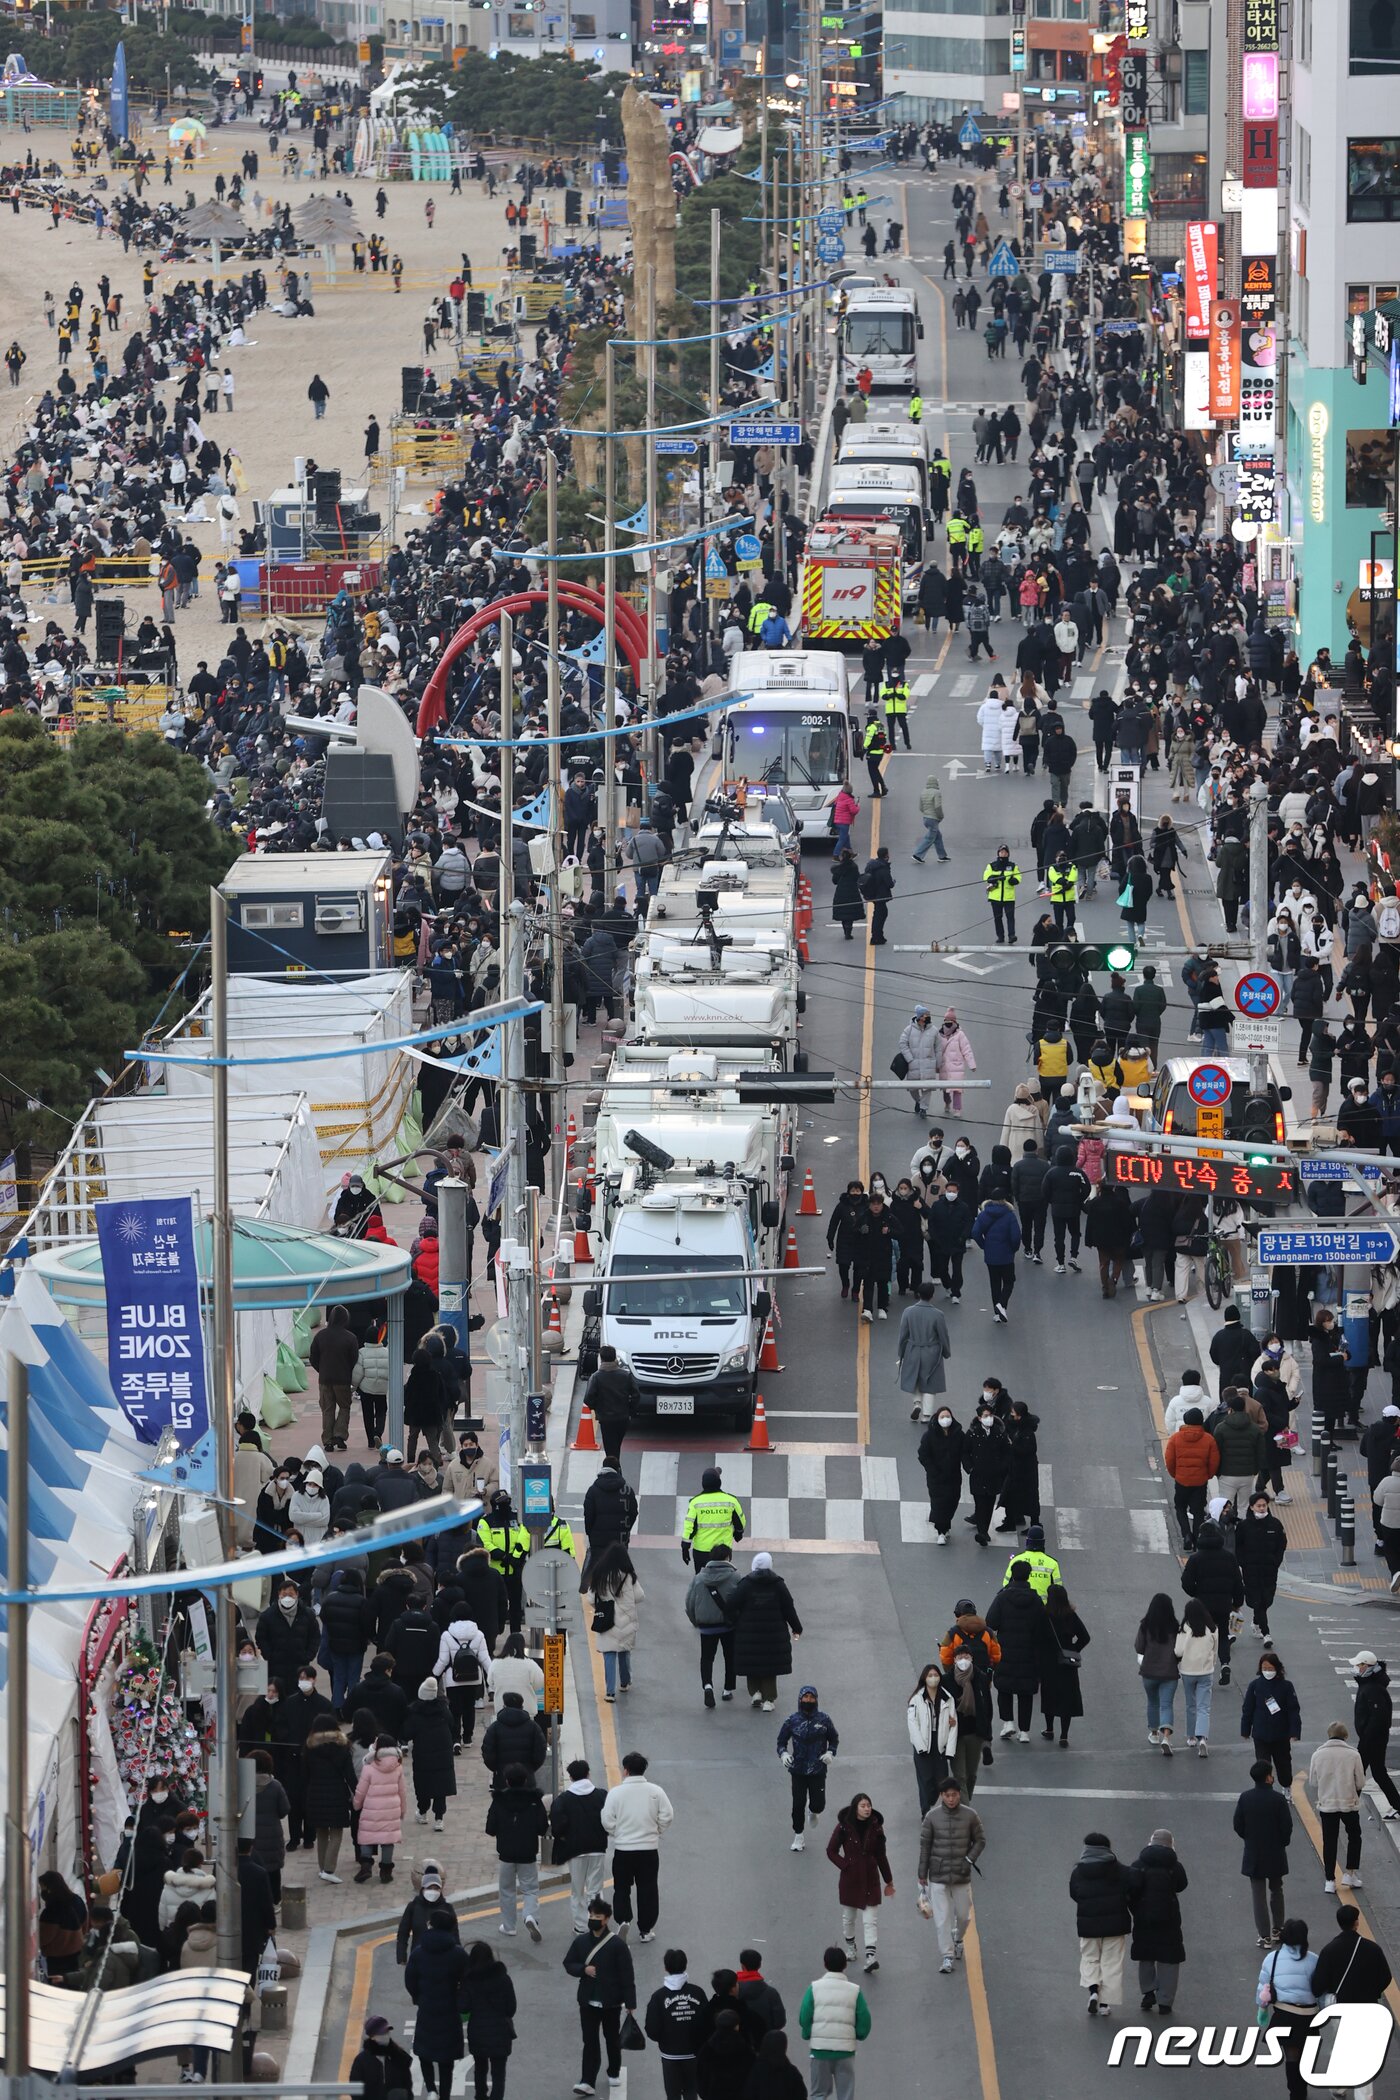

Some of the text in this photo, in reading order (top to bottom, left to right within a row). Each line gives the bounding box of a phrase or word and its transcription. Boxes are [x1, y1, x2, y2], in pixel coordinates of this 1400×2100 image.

[1128, 26, 1148, 37] 4F
[1247, 129, 1273, 159] H
[1216, 329, 1232, 394] 홍콩반점
[1242, 379, 1274, 388] DOO
[1242, 412, 1273, 421] NUT
[736, 426, 783, 436] 광안해변로
[832, 585, 867, 600] 119
[801, 715, 831, 726] 2002-1
[1242, 991, 1272, 1001] 주정차금지
[1195, 1081, 1225, 1089] 주정차금지
[1116, 1155, 1163, 1183] CCTV
[1174, 1160, 1218, 1191] 단속
[1231, 1167, 1262, 1194] 중.
[1263, 1252, 1377, 1262] Gwangnam-ro 130beon-gil
[1253, 1290, 1269, 1299] 207
[653, 1331, 698, 1340] MBC
[547, 1679, 561, 1687] CCTV
